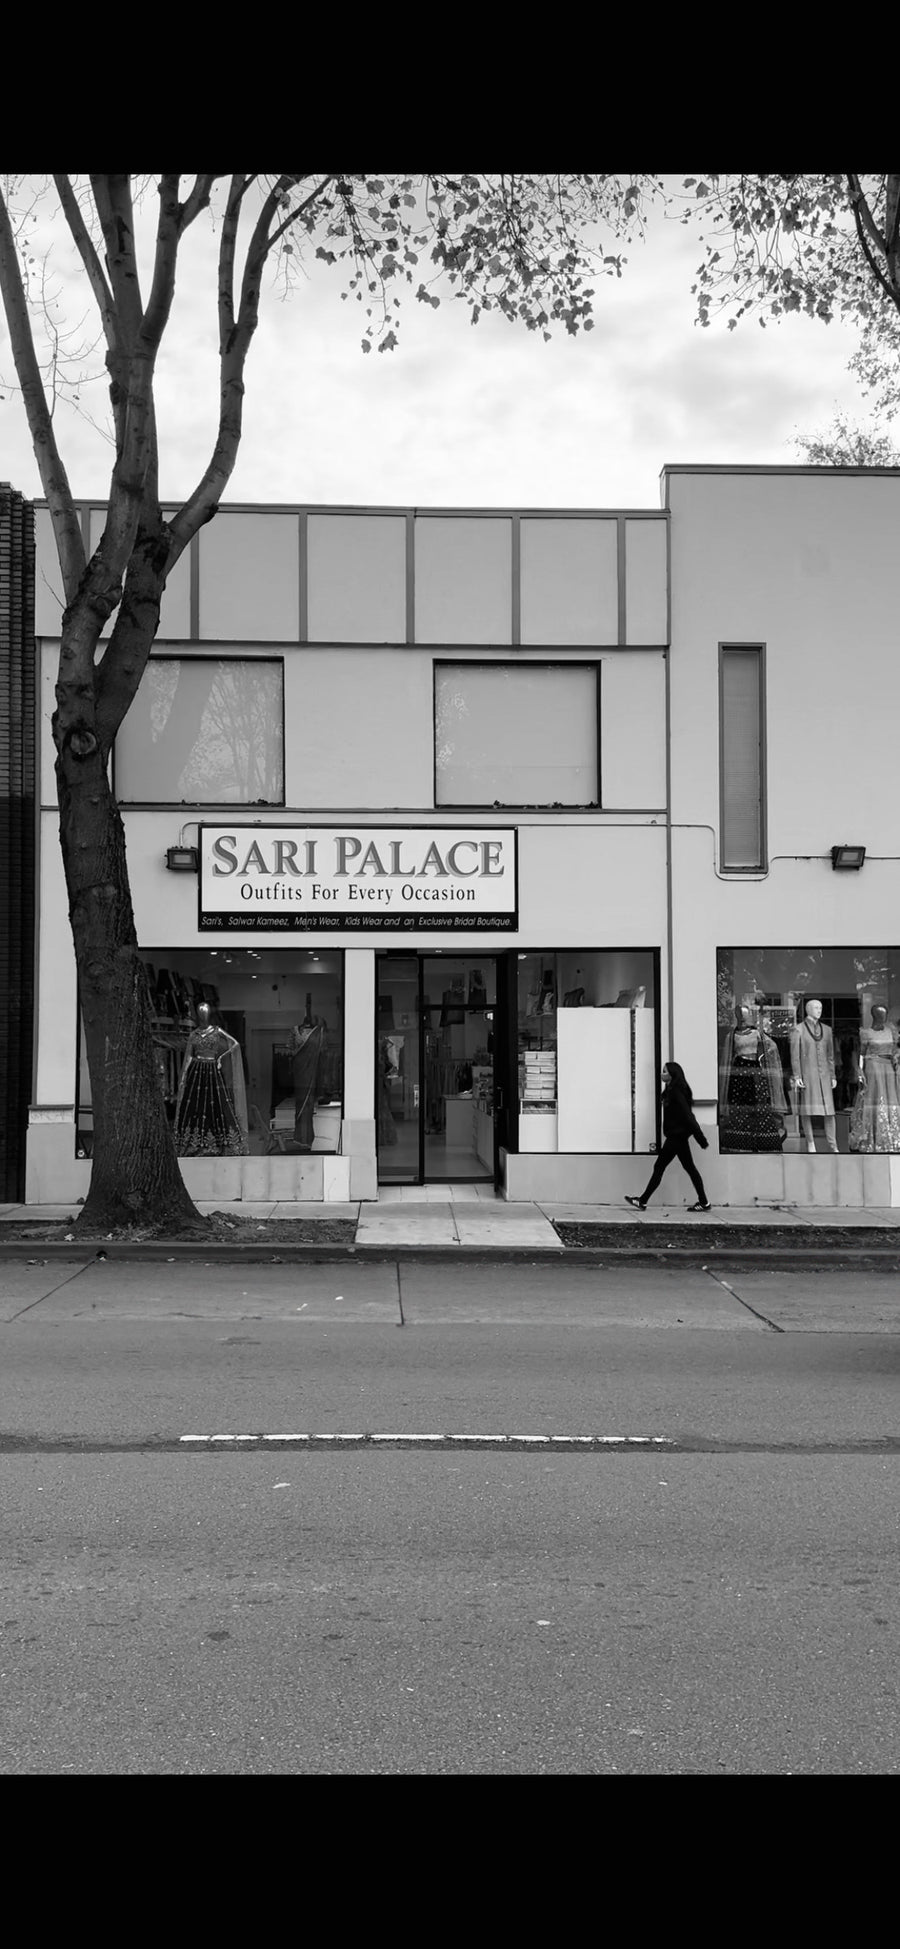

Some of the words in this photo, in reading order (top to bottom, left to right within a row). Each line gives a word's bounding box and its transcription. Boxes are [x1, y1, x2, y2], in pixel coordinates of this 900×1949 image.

[211, 835, 318, 878] SARI
[333, 837, 505, 878] PALACE
[240, 882, 302, 900] Outfits
[312, 884, 339, 900] For
[348, 884, 393, 905] Every
[401, 884, 476, 901] Occasion
[228, 916, 256, 926] Salwar
[294, 916, 317, 926] Men's
[345, 916, 360, 926] Kids
[362, 916, 382, 926] Wear
[383, 916, 401, 926] and
[403, 917, 414, 926] an
[418, 916, 452, 926] Exclusive
[454, 916, 476, 926] Bridal
[477, 916, 512, 927] Boutique.
